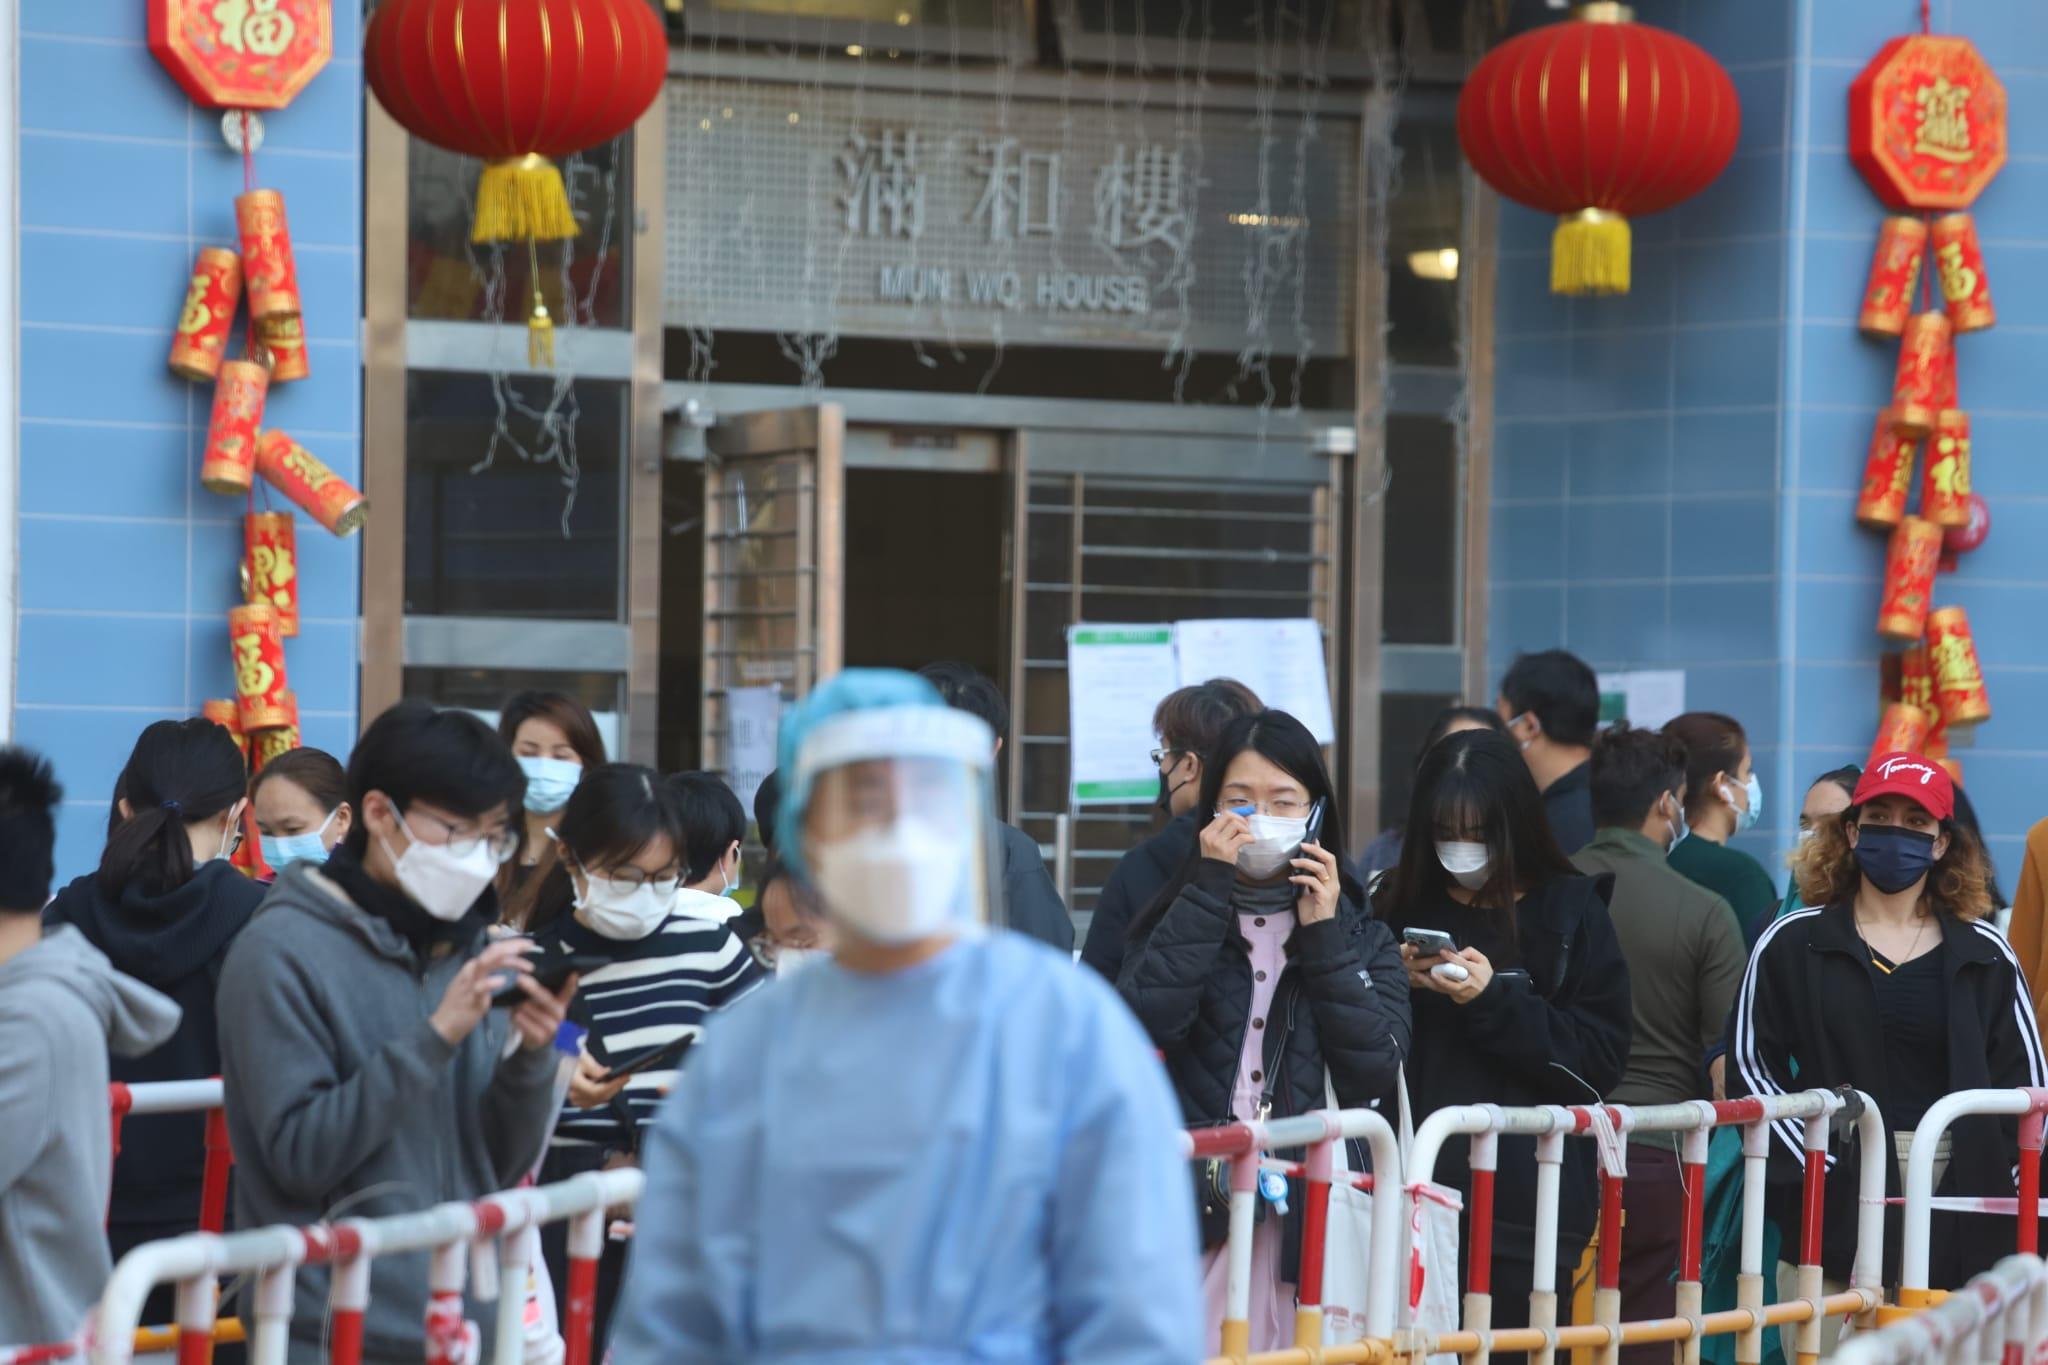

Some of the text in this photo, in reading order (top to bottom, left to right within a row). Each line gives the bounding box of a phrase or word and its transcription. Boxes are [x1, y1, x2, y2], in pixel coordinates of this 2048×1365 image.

[213, 0, 296, 57] 福
[879, 266, 1150, 314] MUN WO HOUSE
[1876, 756, 1937, 785] Tommy
